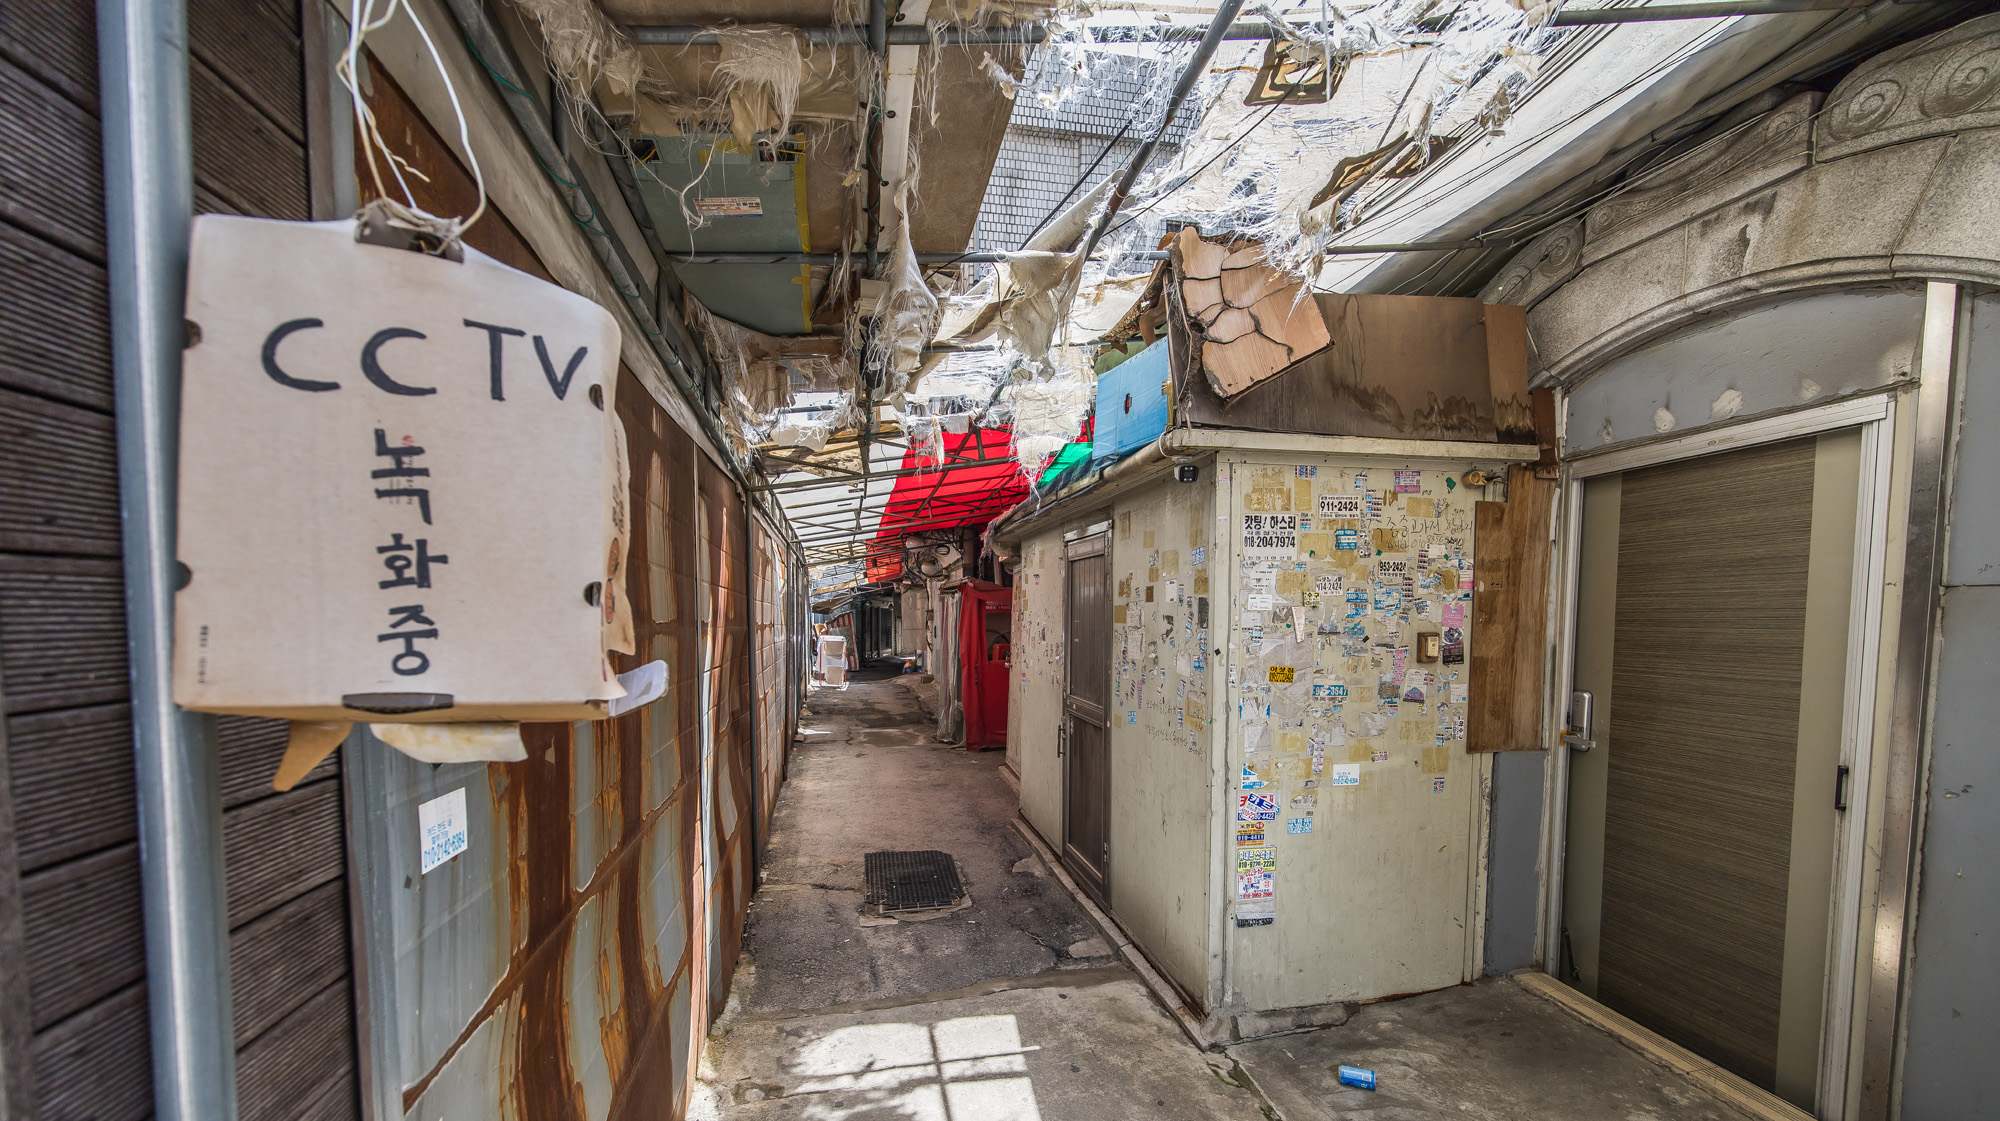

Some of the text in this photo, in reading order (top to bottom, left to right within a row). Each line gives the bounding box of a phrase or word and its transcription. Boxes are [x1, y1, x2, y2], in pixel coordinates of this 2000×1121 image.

[261, 318, 588, 400] CCTV
[371, 428, 449, 676] 녹화중
[1270, 515, 1296, 530] 하스리
